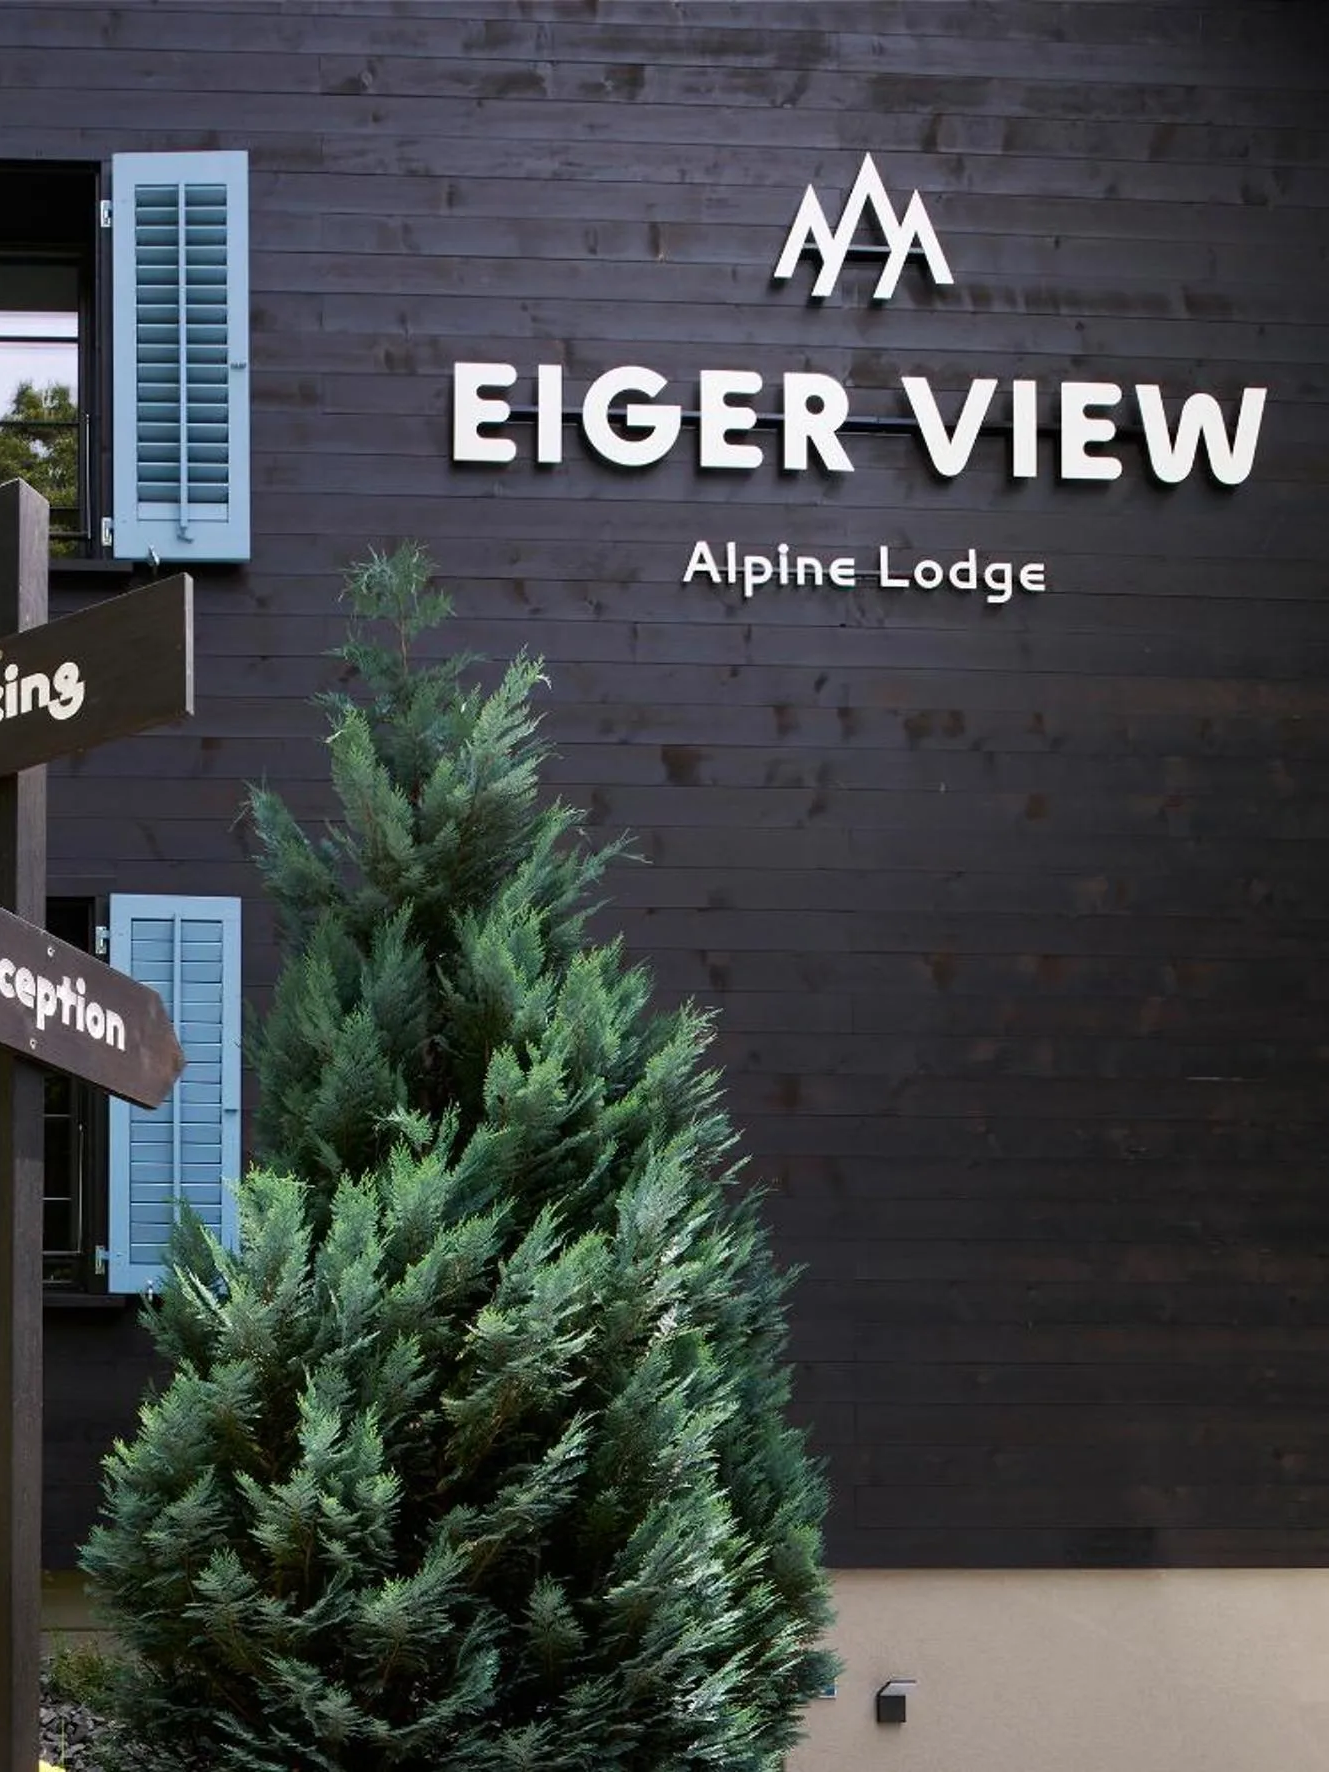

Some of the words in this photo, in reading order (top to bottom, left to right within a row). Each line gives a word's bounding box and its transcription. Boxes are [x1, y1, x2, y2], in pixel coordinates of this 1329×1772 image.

[452, 360, 857, 474] EIGER
[899, 375, 1269, 486] VIEW
[682, 540, 857, 600] Alpine
[878, 545, 1047, 604] Lodge
